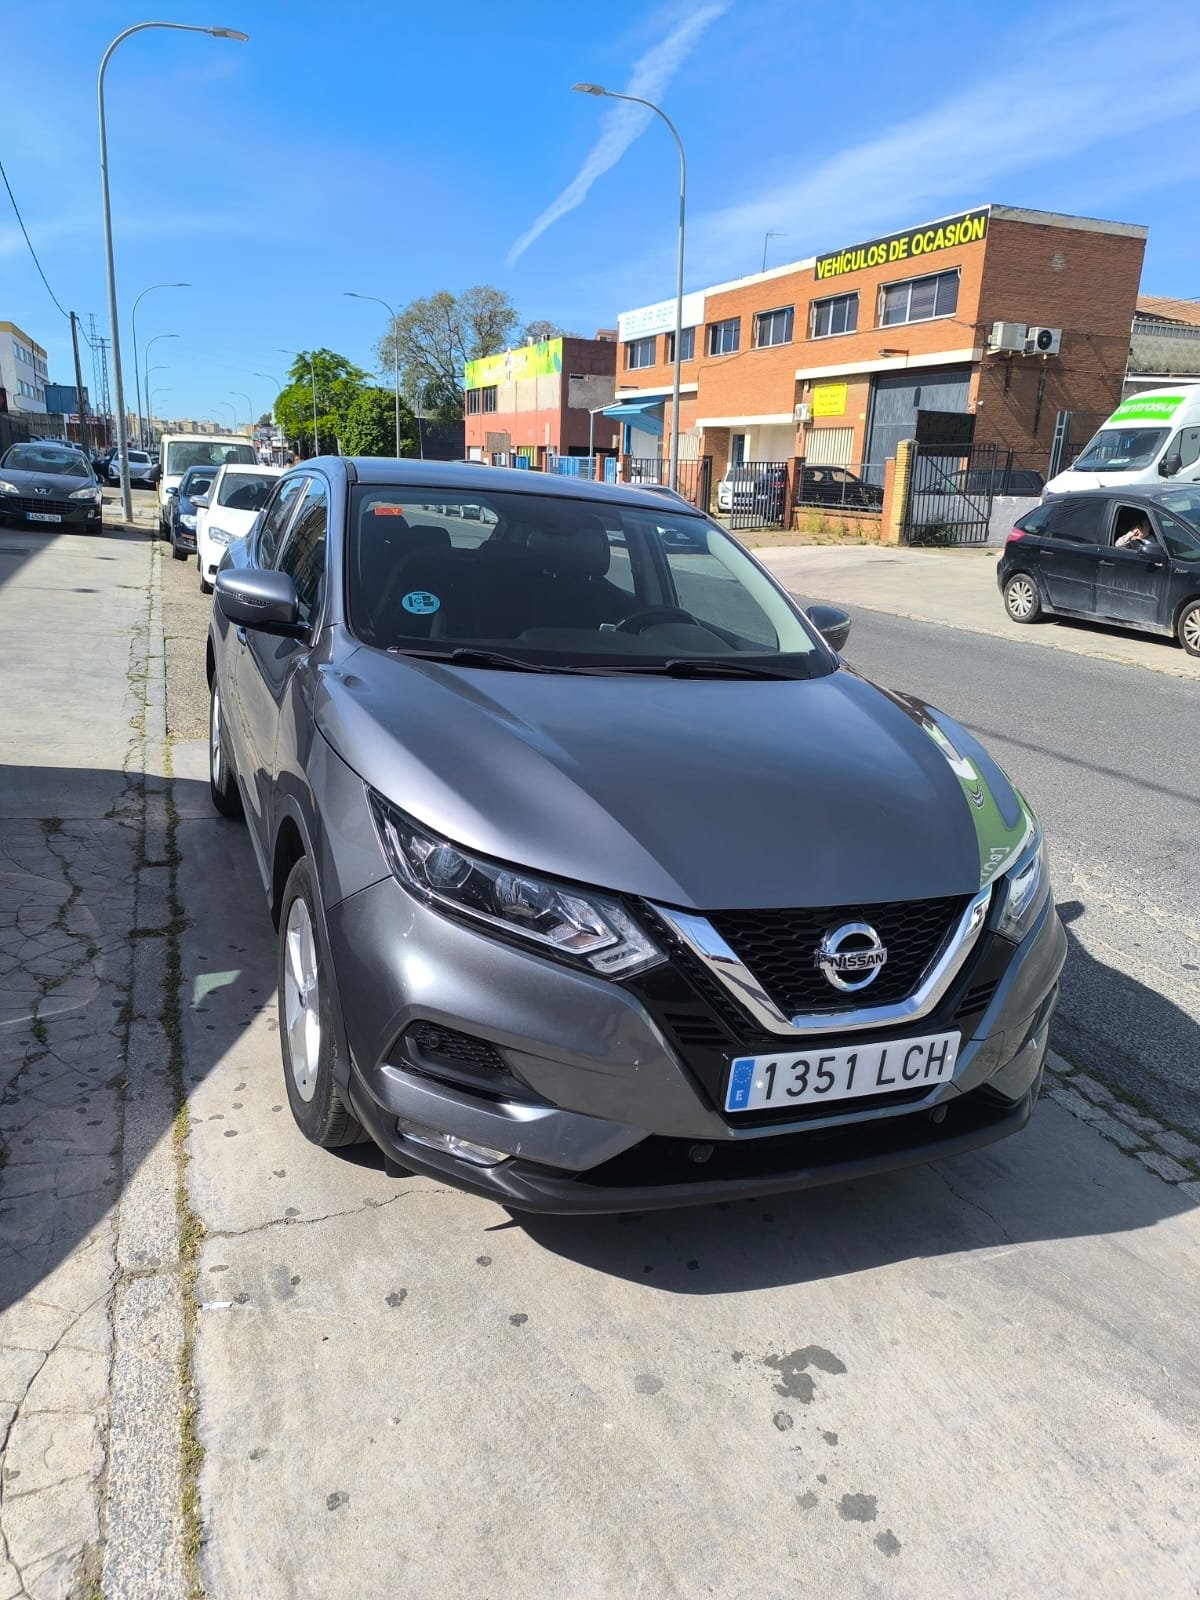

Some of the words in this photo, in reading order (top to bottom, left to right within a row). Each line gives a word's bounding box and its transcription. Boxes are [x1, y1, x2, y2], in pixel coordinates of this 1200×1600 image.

[816, 243, 887, 280] VEHÍCULOS
[889, 237, 909, 263] DE
[911, 215, 986, 255] OCASIÓN
[830, 952, 884, 969] NISSAN
[765, 1053, 858, 1101] 1351
[876, 1040, 949, 1087] LCH
[736, 1089, 744, 1101] E
